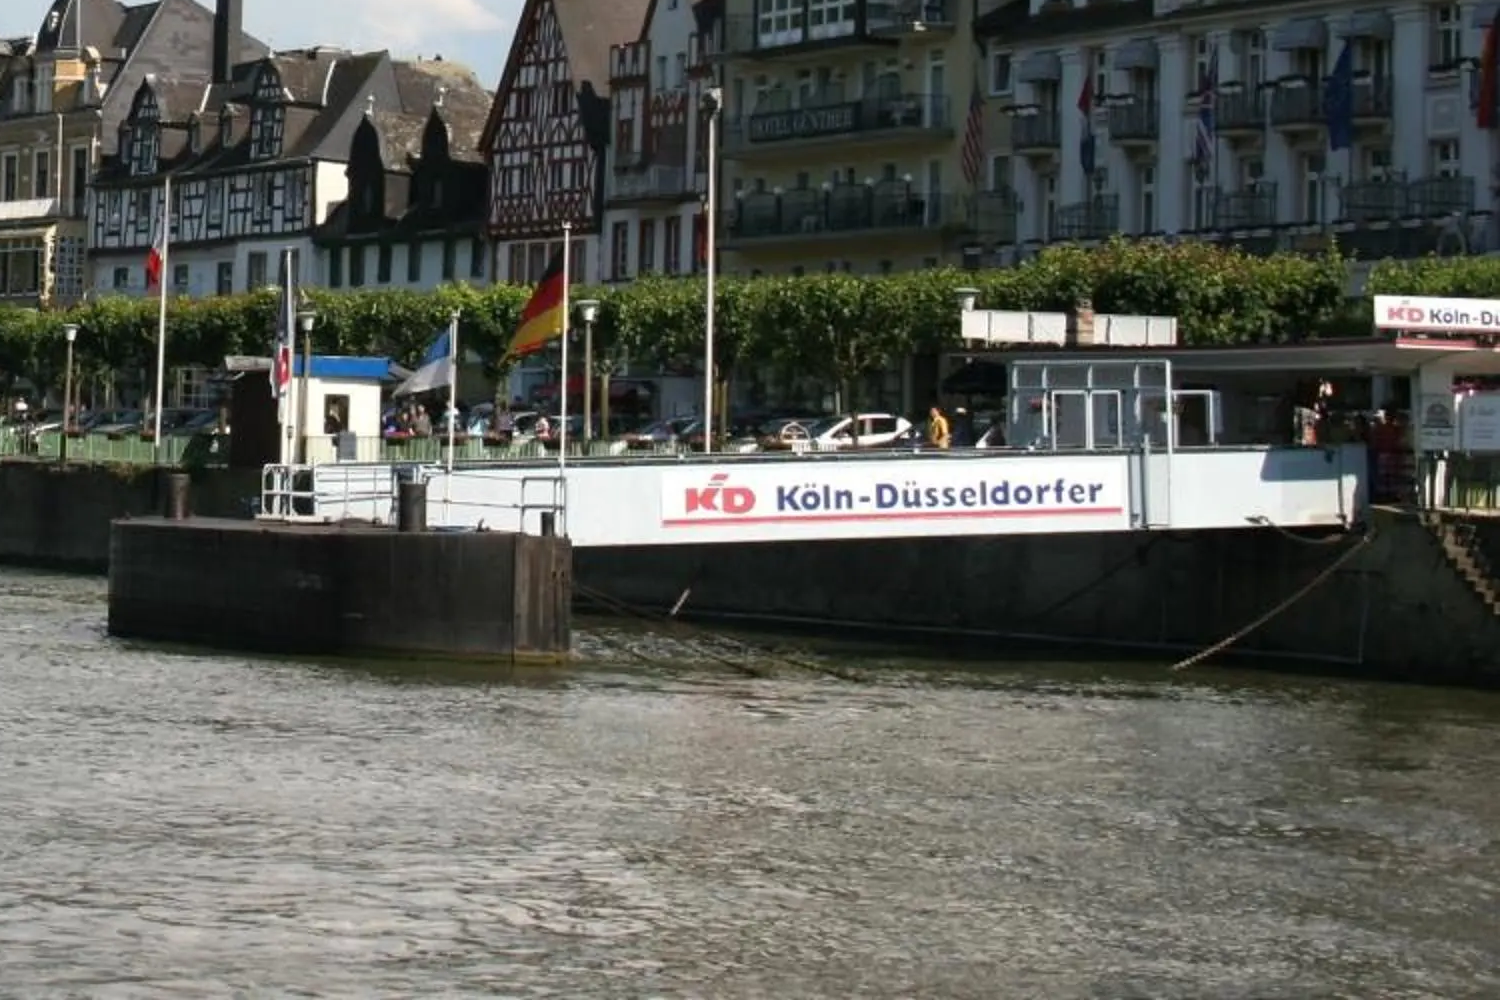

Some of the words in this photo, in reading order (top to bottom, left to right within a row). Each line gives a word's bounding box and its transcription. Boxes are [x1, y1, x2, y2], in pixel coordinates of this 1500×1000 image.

[1387, 307, 1425, 323] KD
[685, 474, 756, 514] KD
[777, 478, 1103, 512] Köln-Düsseldorfer
